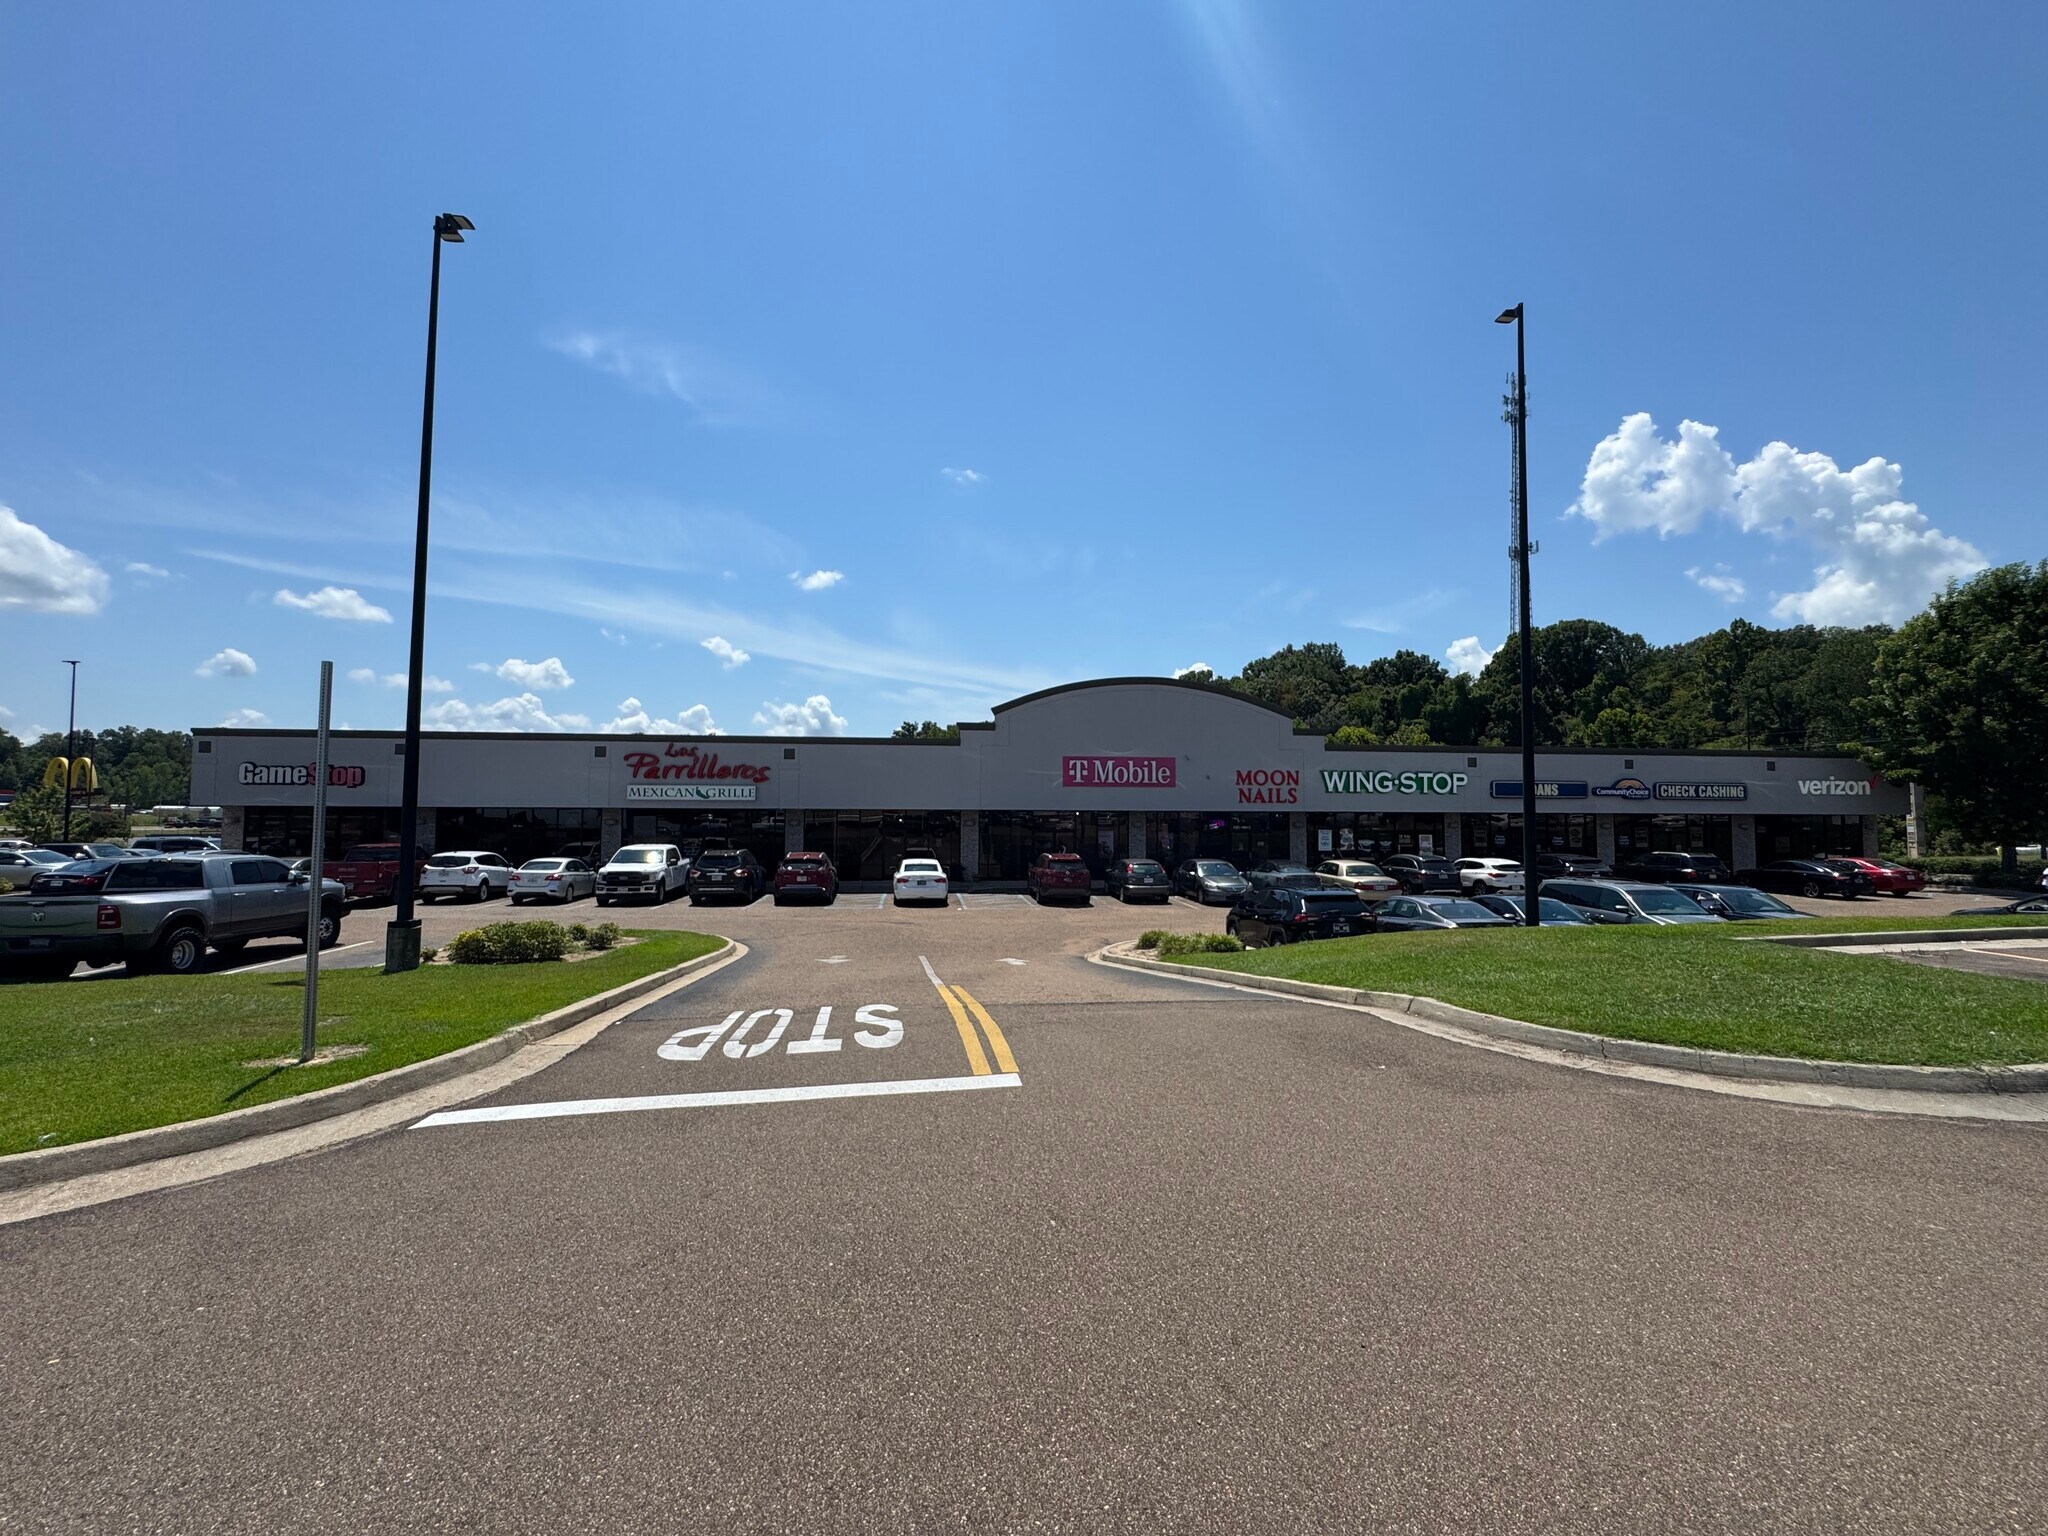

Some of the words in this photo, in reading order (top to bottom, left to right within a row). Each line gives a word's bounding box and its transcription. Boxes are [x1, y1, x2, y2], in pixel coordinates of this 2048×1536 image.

[1092, 760, 1171, 784] Mobile
[1235, 770, 1300, 786] MOON
[628, 786, 695, 799] MEXICAN
[706, 786, 756, 799] GRILLE
[1660, 785, 1696, 798] CHECK
[1699, 786, 1745, 798] CASHING
[1797, 776, 1871, 796] verizon
[1238, 788, 1298, 804] NAILS
[656, 1003, 905, 1061] STOP
